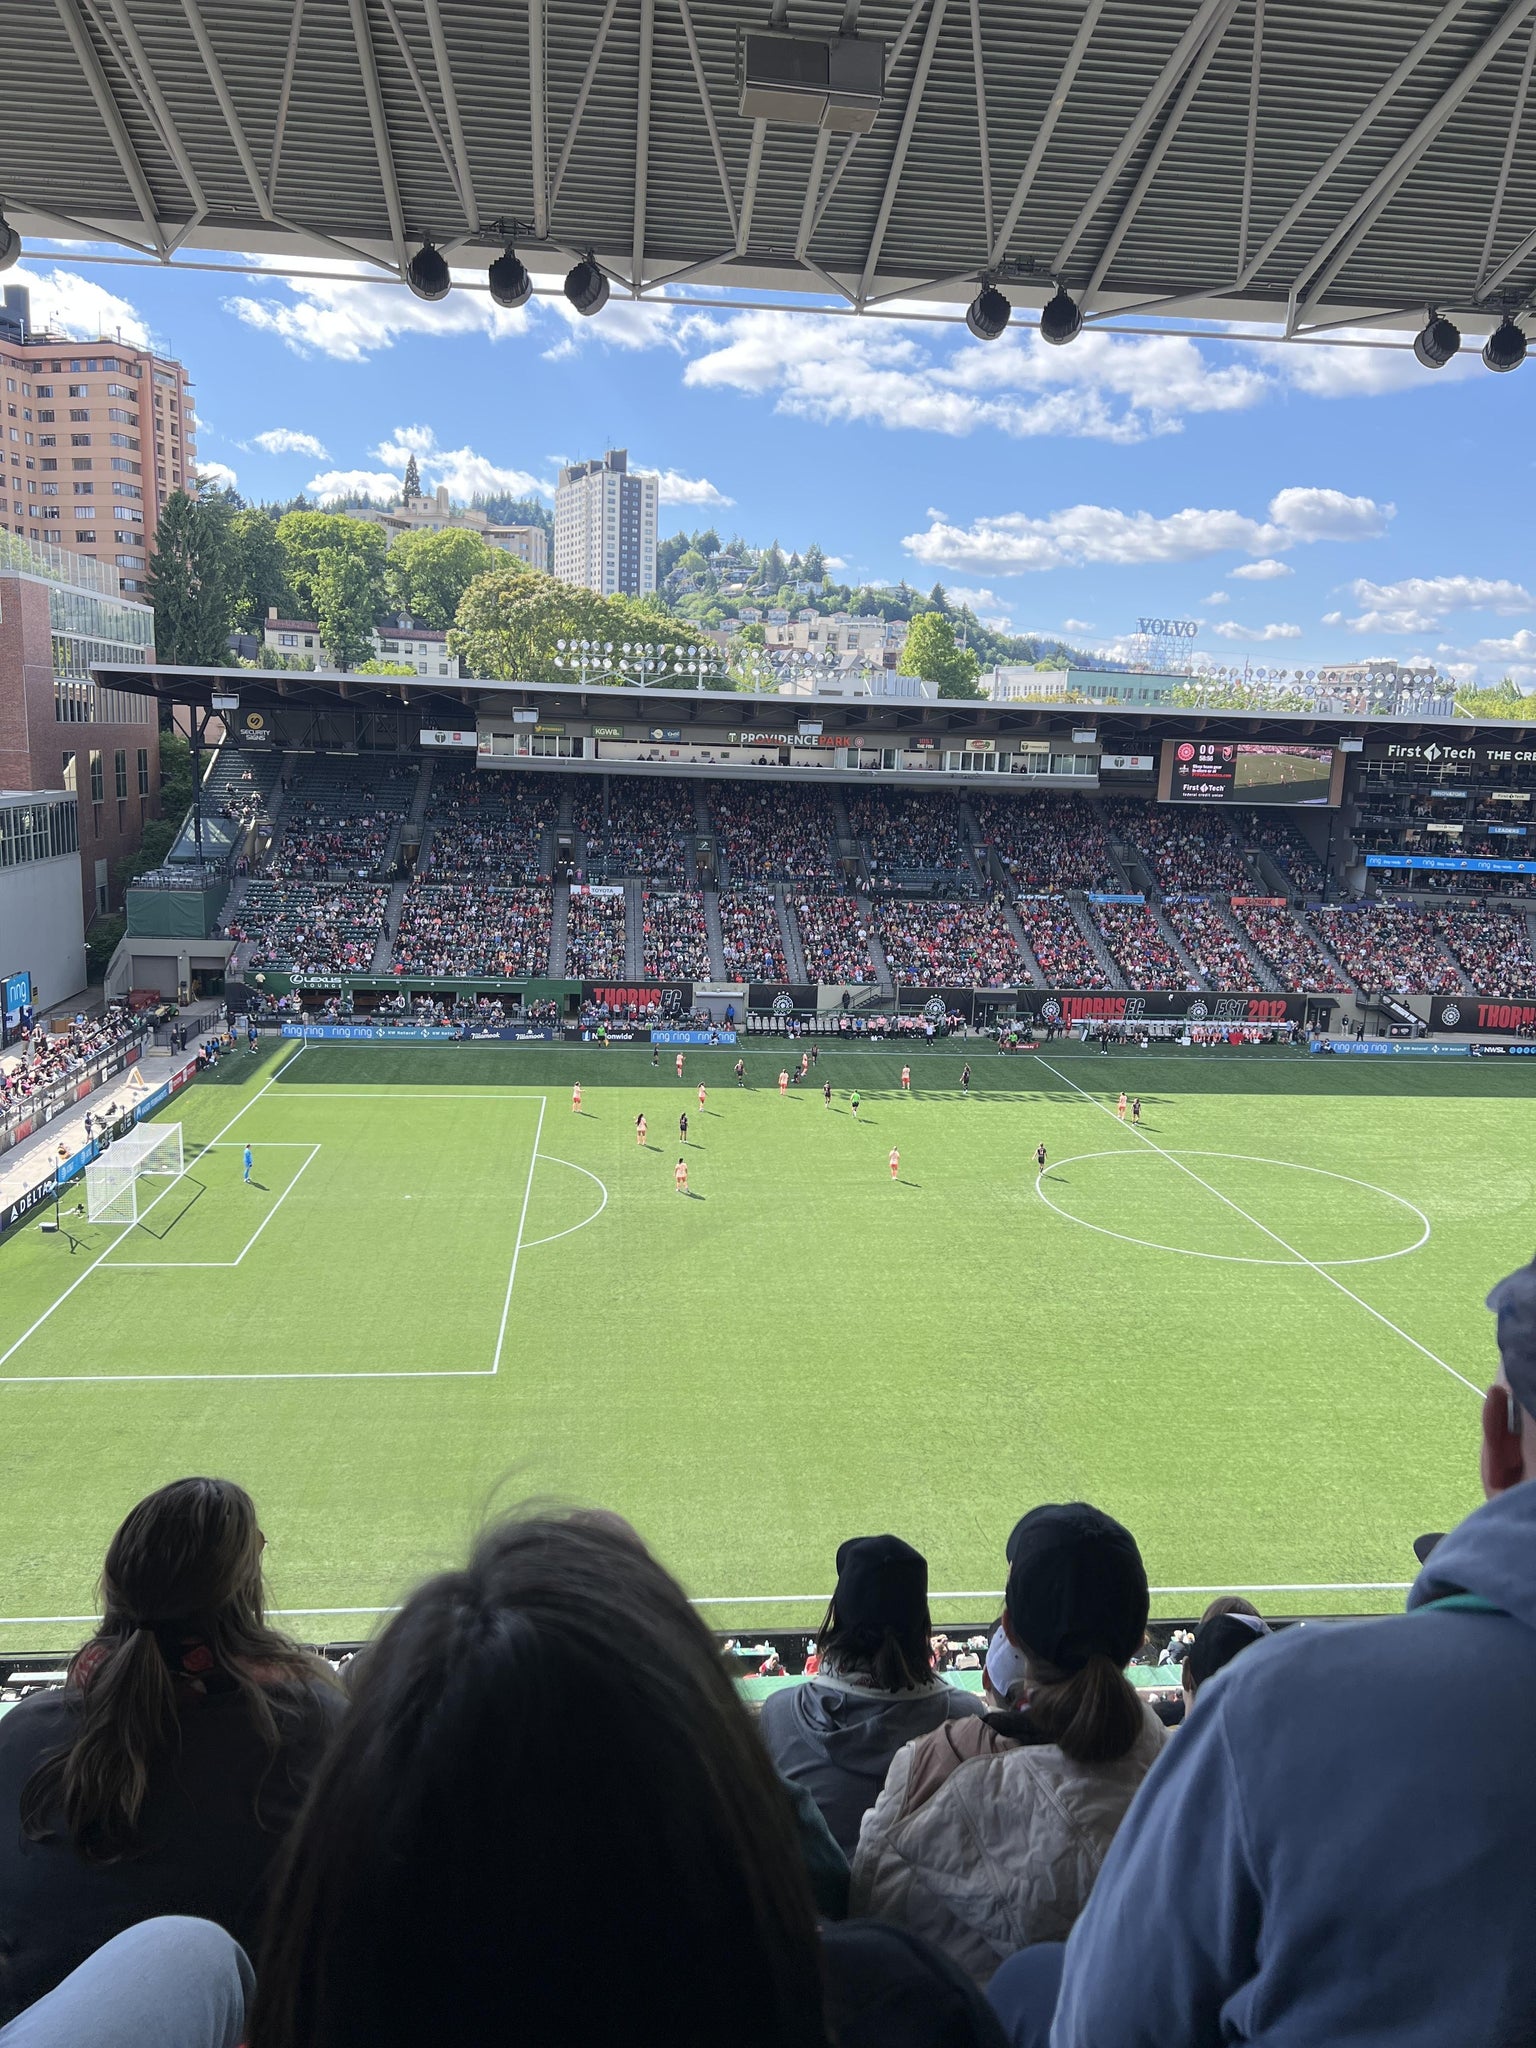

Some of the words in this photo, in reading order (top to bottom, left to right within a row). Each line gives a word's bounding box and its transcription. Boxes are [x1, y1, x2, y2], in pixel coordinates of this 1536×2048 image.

[1137, 617, 1198, 637] VOLVO
[740, 733, 818, 745] PROVIDENCE
[819, 735, 850, 746] PARK
[1200, 744, 1206, 755] 0
[1208, 744, 1215, 755] 0
[1388, 745, 1421, 758] First
[1442, 747, 1476, 759] Tech
[1486, 751, 1512, 760] THE
[1370, 857, 1382, 865] ring
[1422, 859, 1435, 867] ring
[1478, 862, 1491, 870] ring
[9, 981, 27, 1003] ring
[593, 987, 662, 1013] THORNS
[1061, 997, 1126, 1020] THORNS
[1247, 999, 1287, 1022] 2012
[1477, 1004, 1536, 1029] THORN
[283, 1026, 303, 1037] ring
[304, 1027, 325, 1038] ring
[332, 1027, 351, 1038] ring
[353, 1028, 373, 1039] ring
[471, 1032, 501, 1040] Tillamook
[515, 1032, 545, 1041] Tillamook
[591, 1032, 633, 1040] Nionwide
[652, 1032, 670, 1042] ring
[673, 1032, 690, 1042] ring
[1333, 1043, 1350, 1053] ring
[1352, 1043, 1369, 1053] ring
[1371, 1044, 1388, 1054] ring
